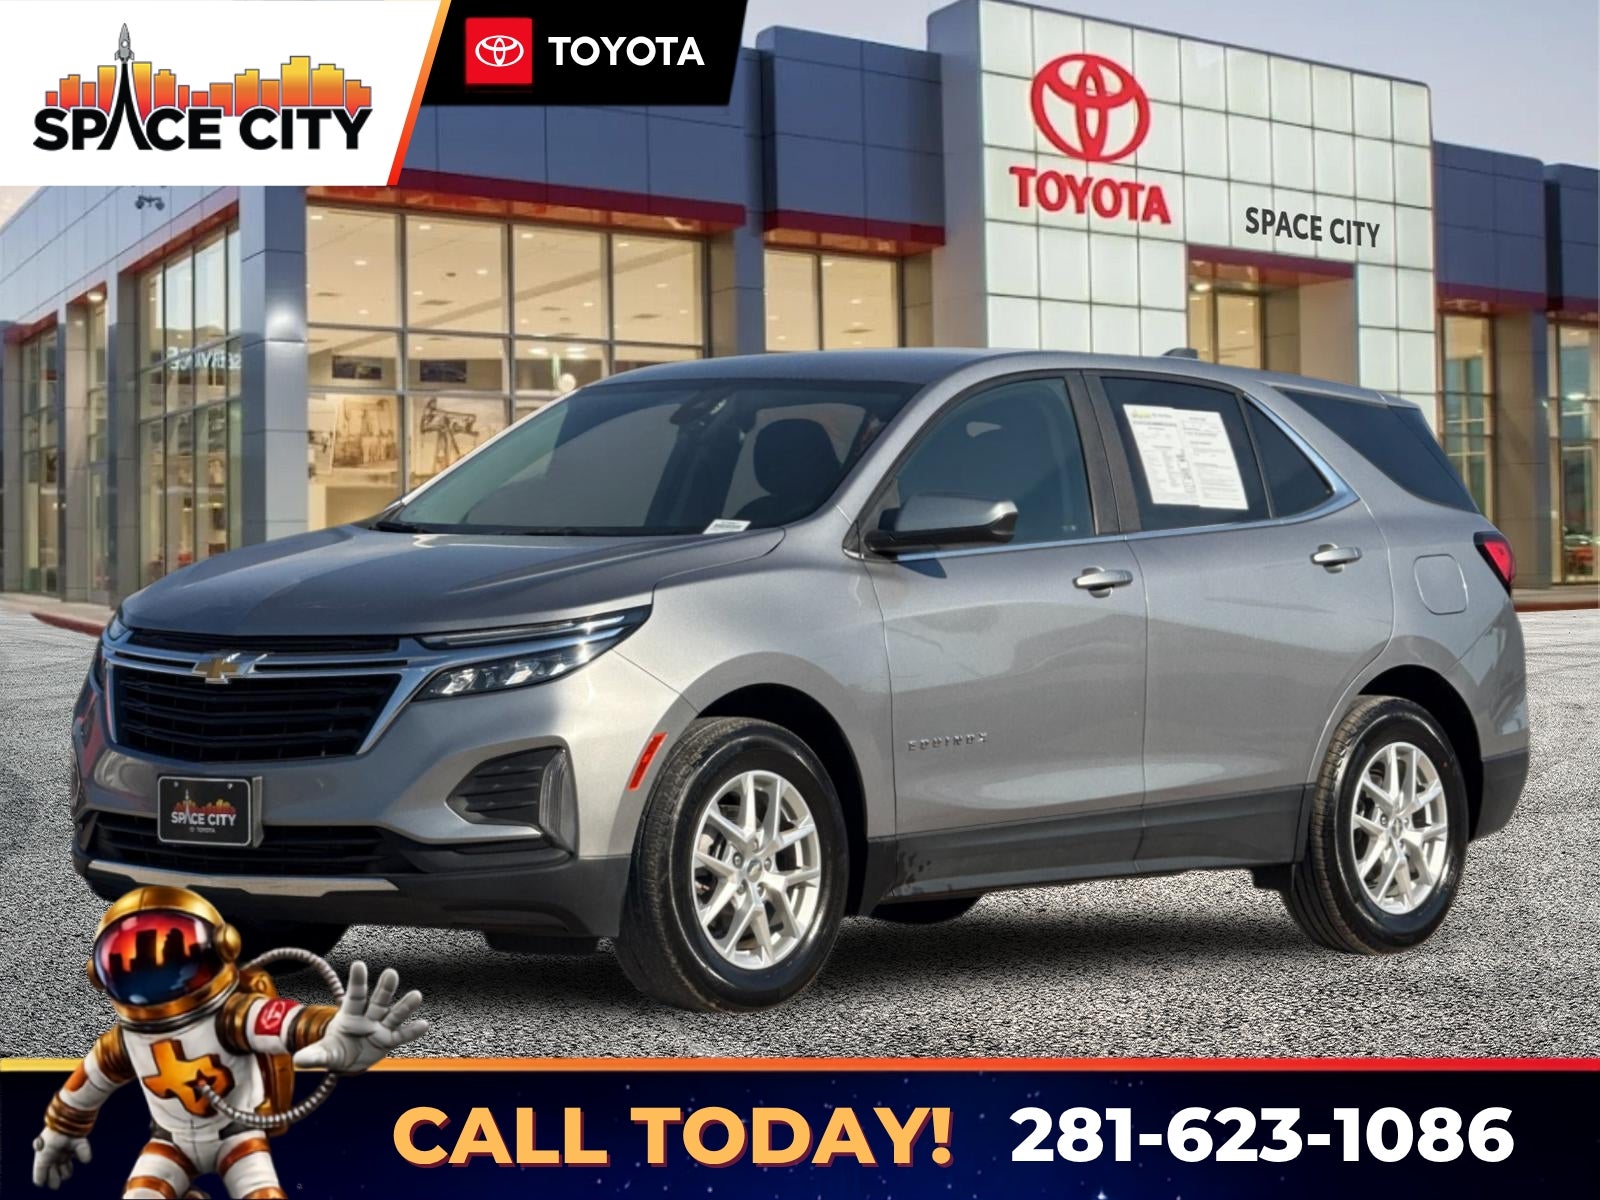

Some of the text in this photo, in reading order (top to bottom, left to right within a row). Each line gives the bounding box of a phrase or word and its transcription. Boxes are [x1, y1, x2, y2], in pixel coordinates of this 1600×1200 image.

[1009, 166, 1171, 224] TOYOTA
[1245, 207, 1380, 248] SPACE CITY
[908, 732, 988, 751] EQUINOX
[171, 811, 236, 826] SPACE CITY
